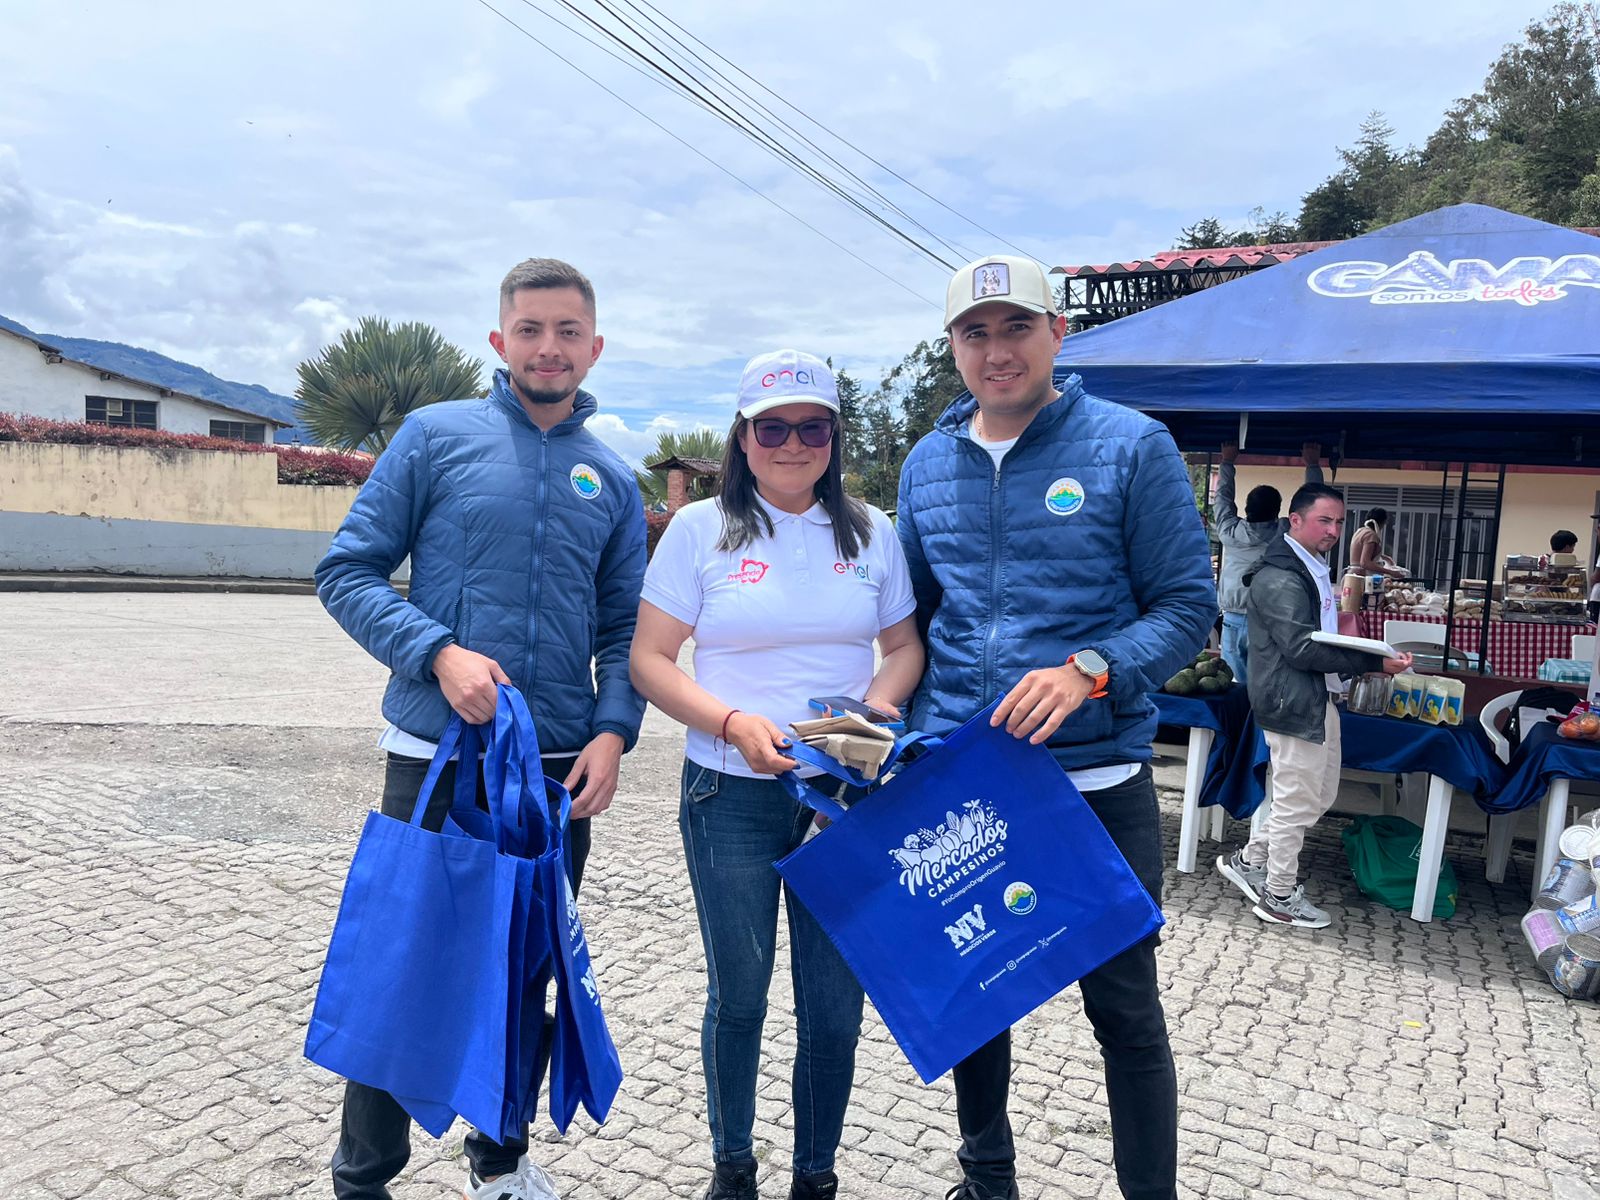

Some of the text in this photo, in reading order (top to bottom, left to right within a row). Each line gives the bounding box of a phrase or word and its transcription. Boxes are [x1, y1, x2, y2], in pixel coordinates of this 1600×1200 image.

[1307, 251, 1600, 297] GAMA
[1378, 279, 1560, 304] somos todos
[761, 368, 817, 388] enel
[833, 562, 871, 582] enel
[899, 818, 1008, 896] Mercados
[928, 842, 1005, 898] CAMPESINOS
[941, 860, 1006, 907] #YoComproOrigenGuavio
[943, 903, 987, 950] NV
